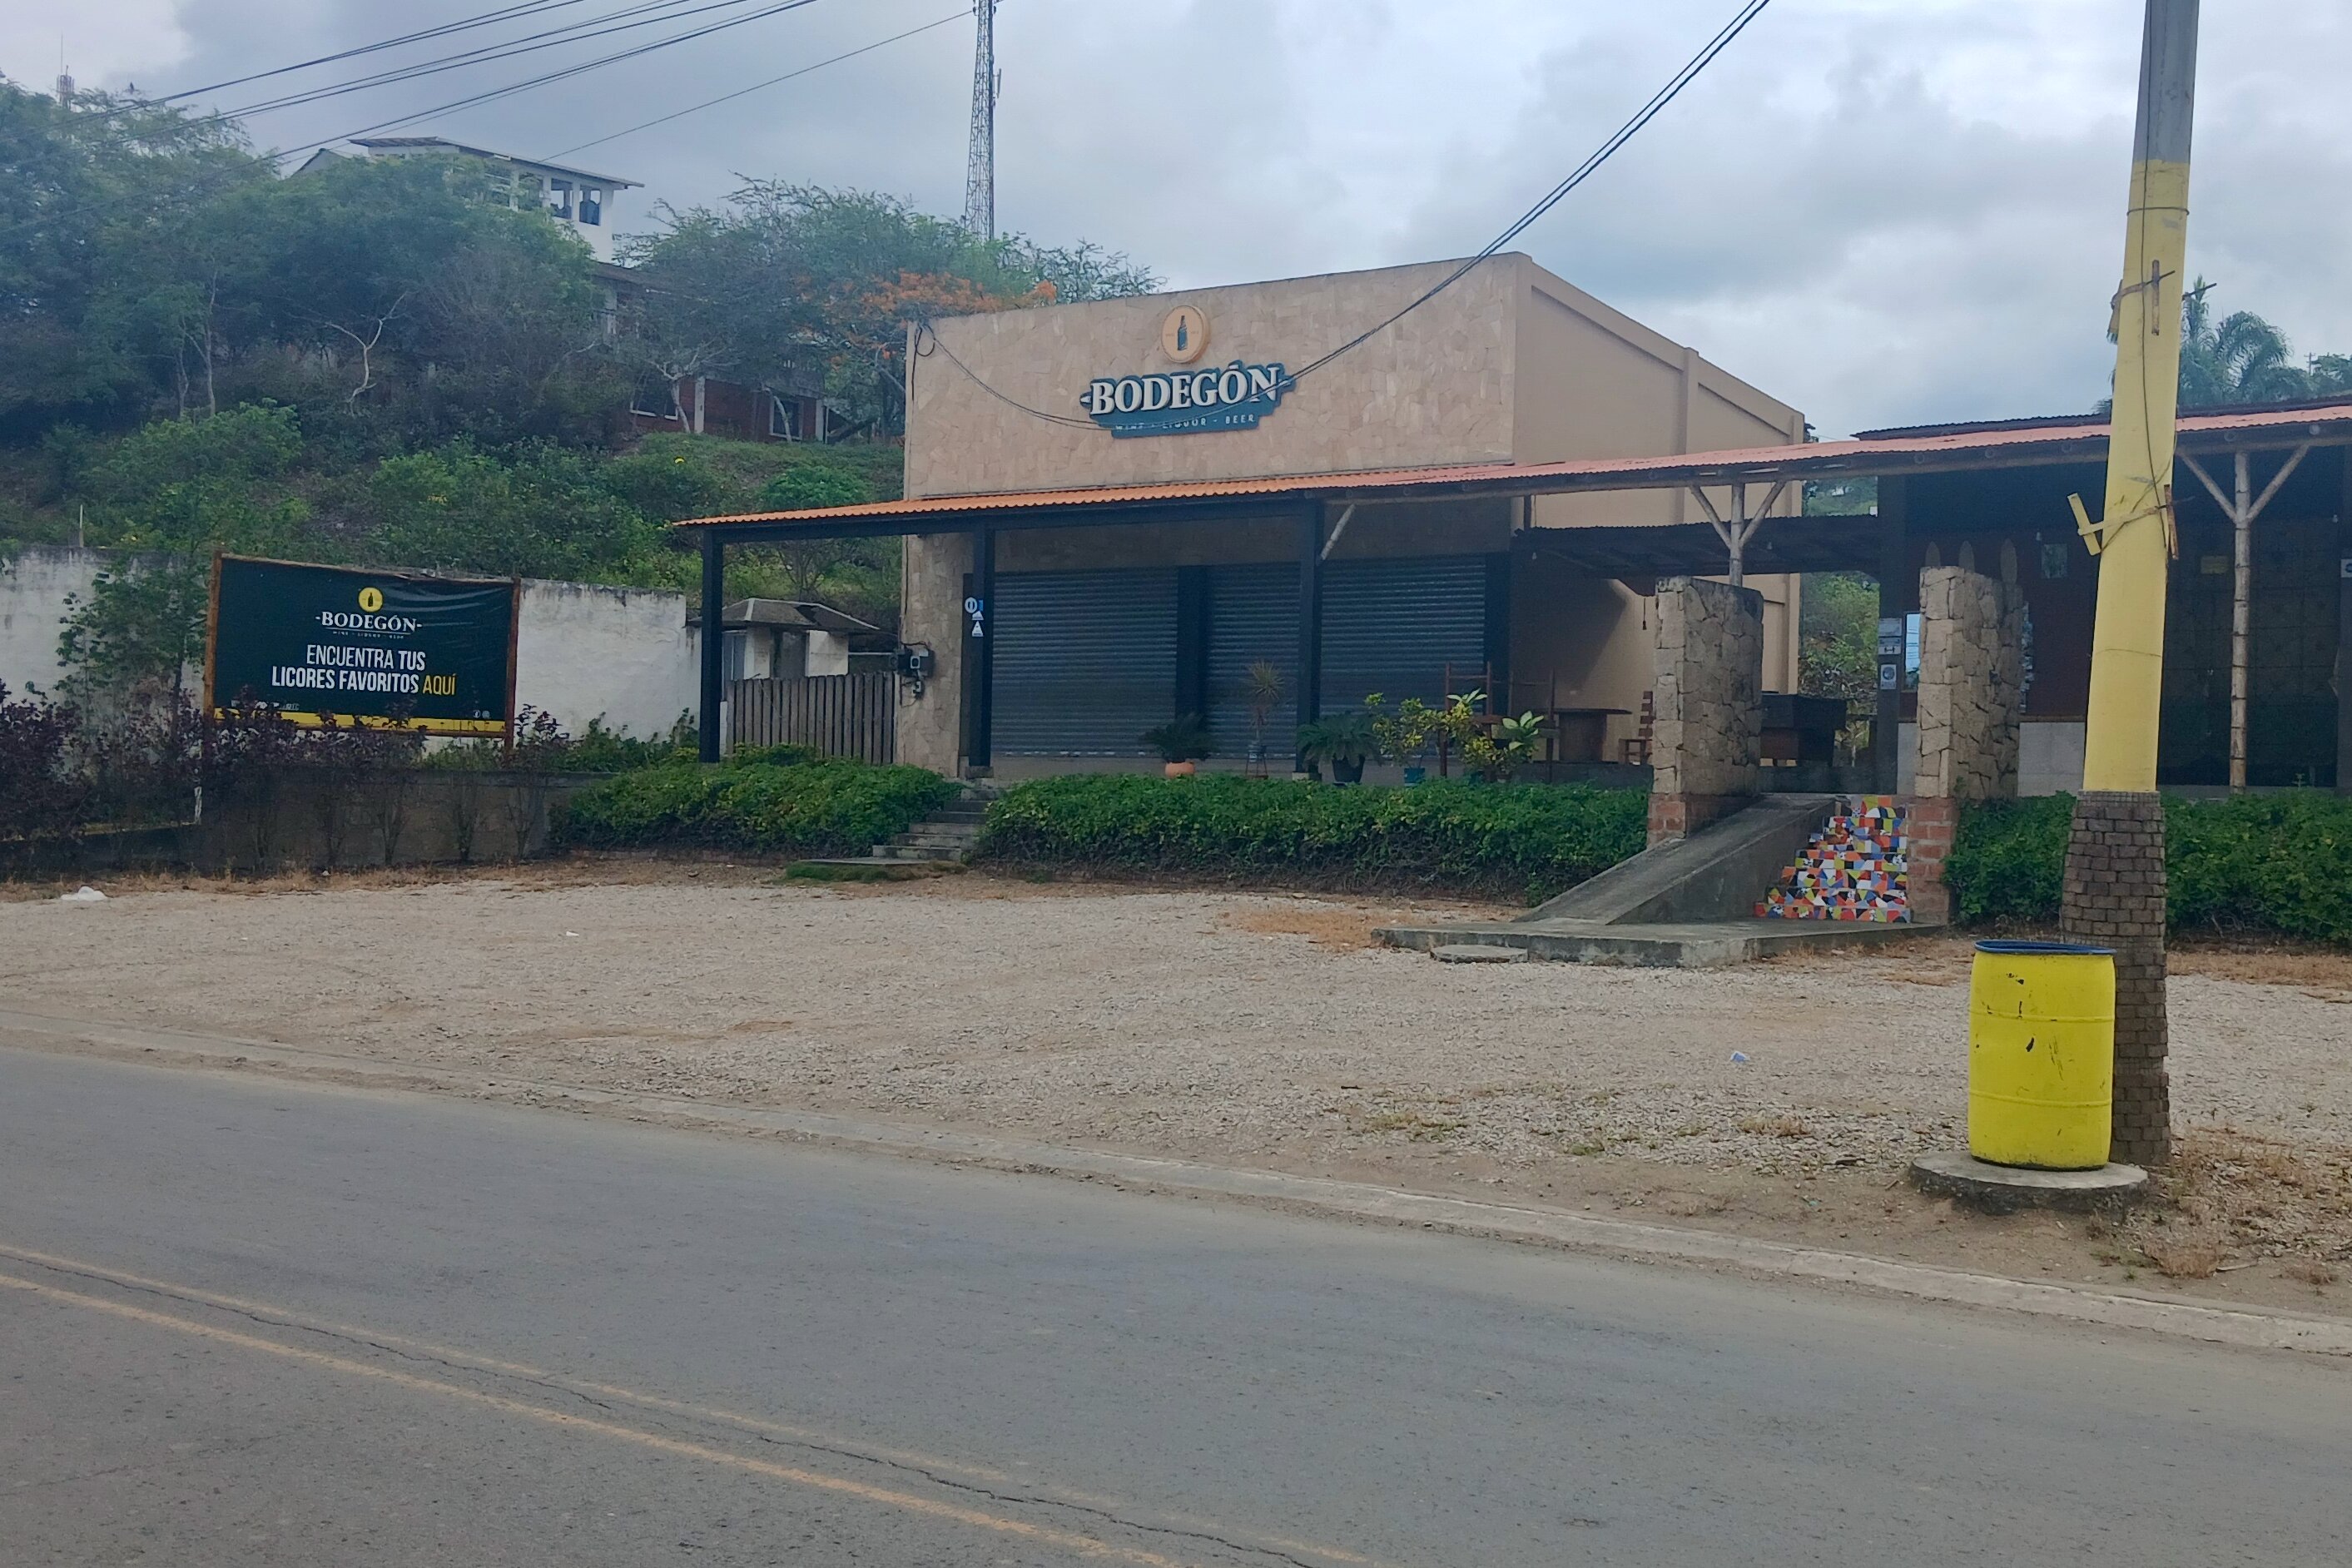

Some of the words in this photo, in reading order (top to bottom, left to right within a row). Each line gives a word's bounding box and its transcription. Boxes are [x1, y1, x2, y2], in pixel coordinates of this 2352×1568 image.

[1089, 365, 1281, 415] BODEGÓN
[1225, 414, 1255, 424] BEER
[306, 644, 394, 669] ENCUENTRA
[397, 650, 426, 671] TUS
[271, 666, 335, 689] LICORES
[339, 670, 419, 694] FAVORITOS
[422, 672, 457, 696] AQUÍ
